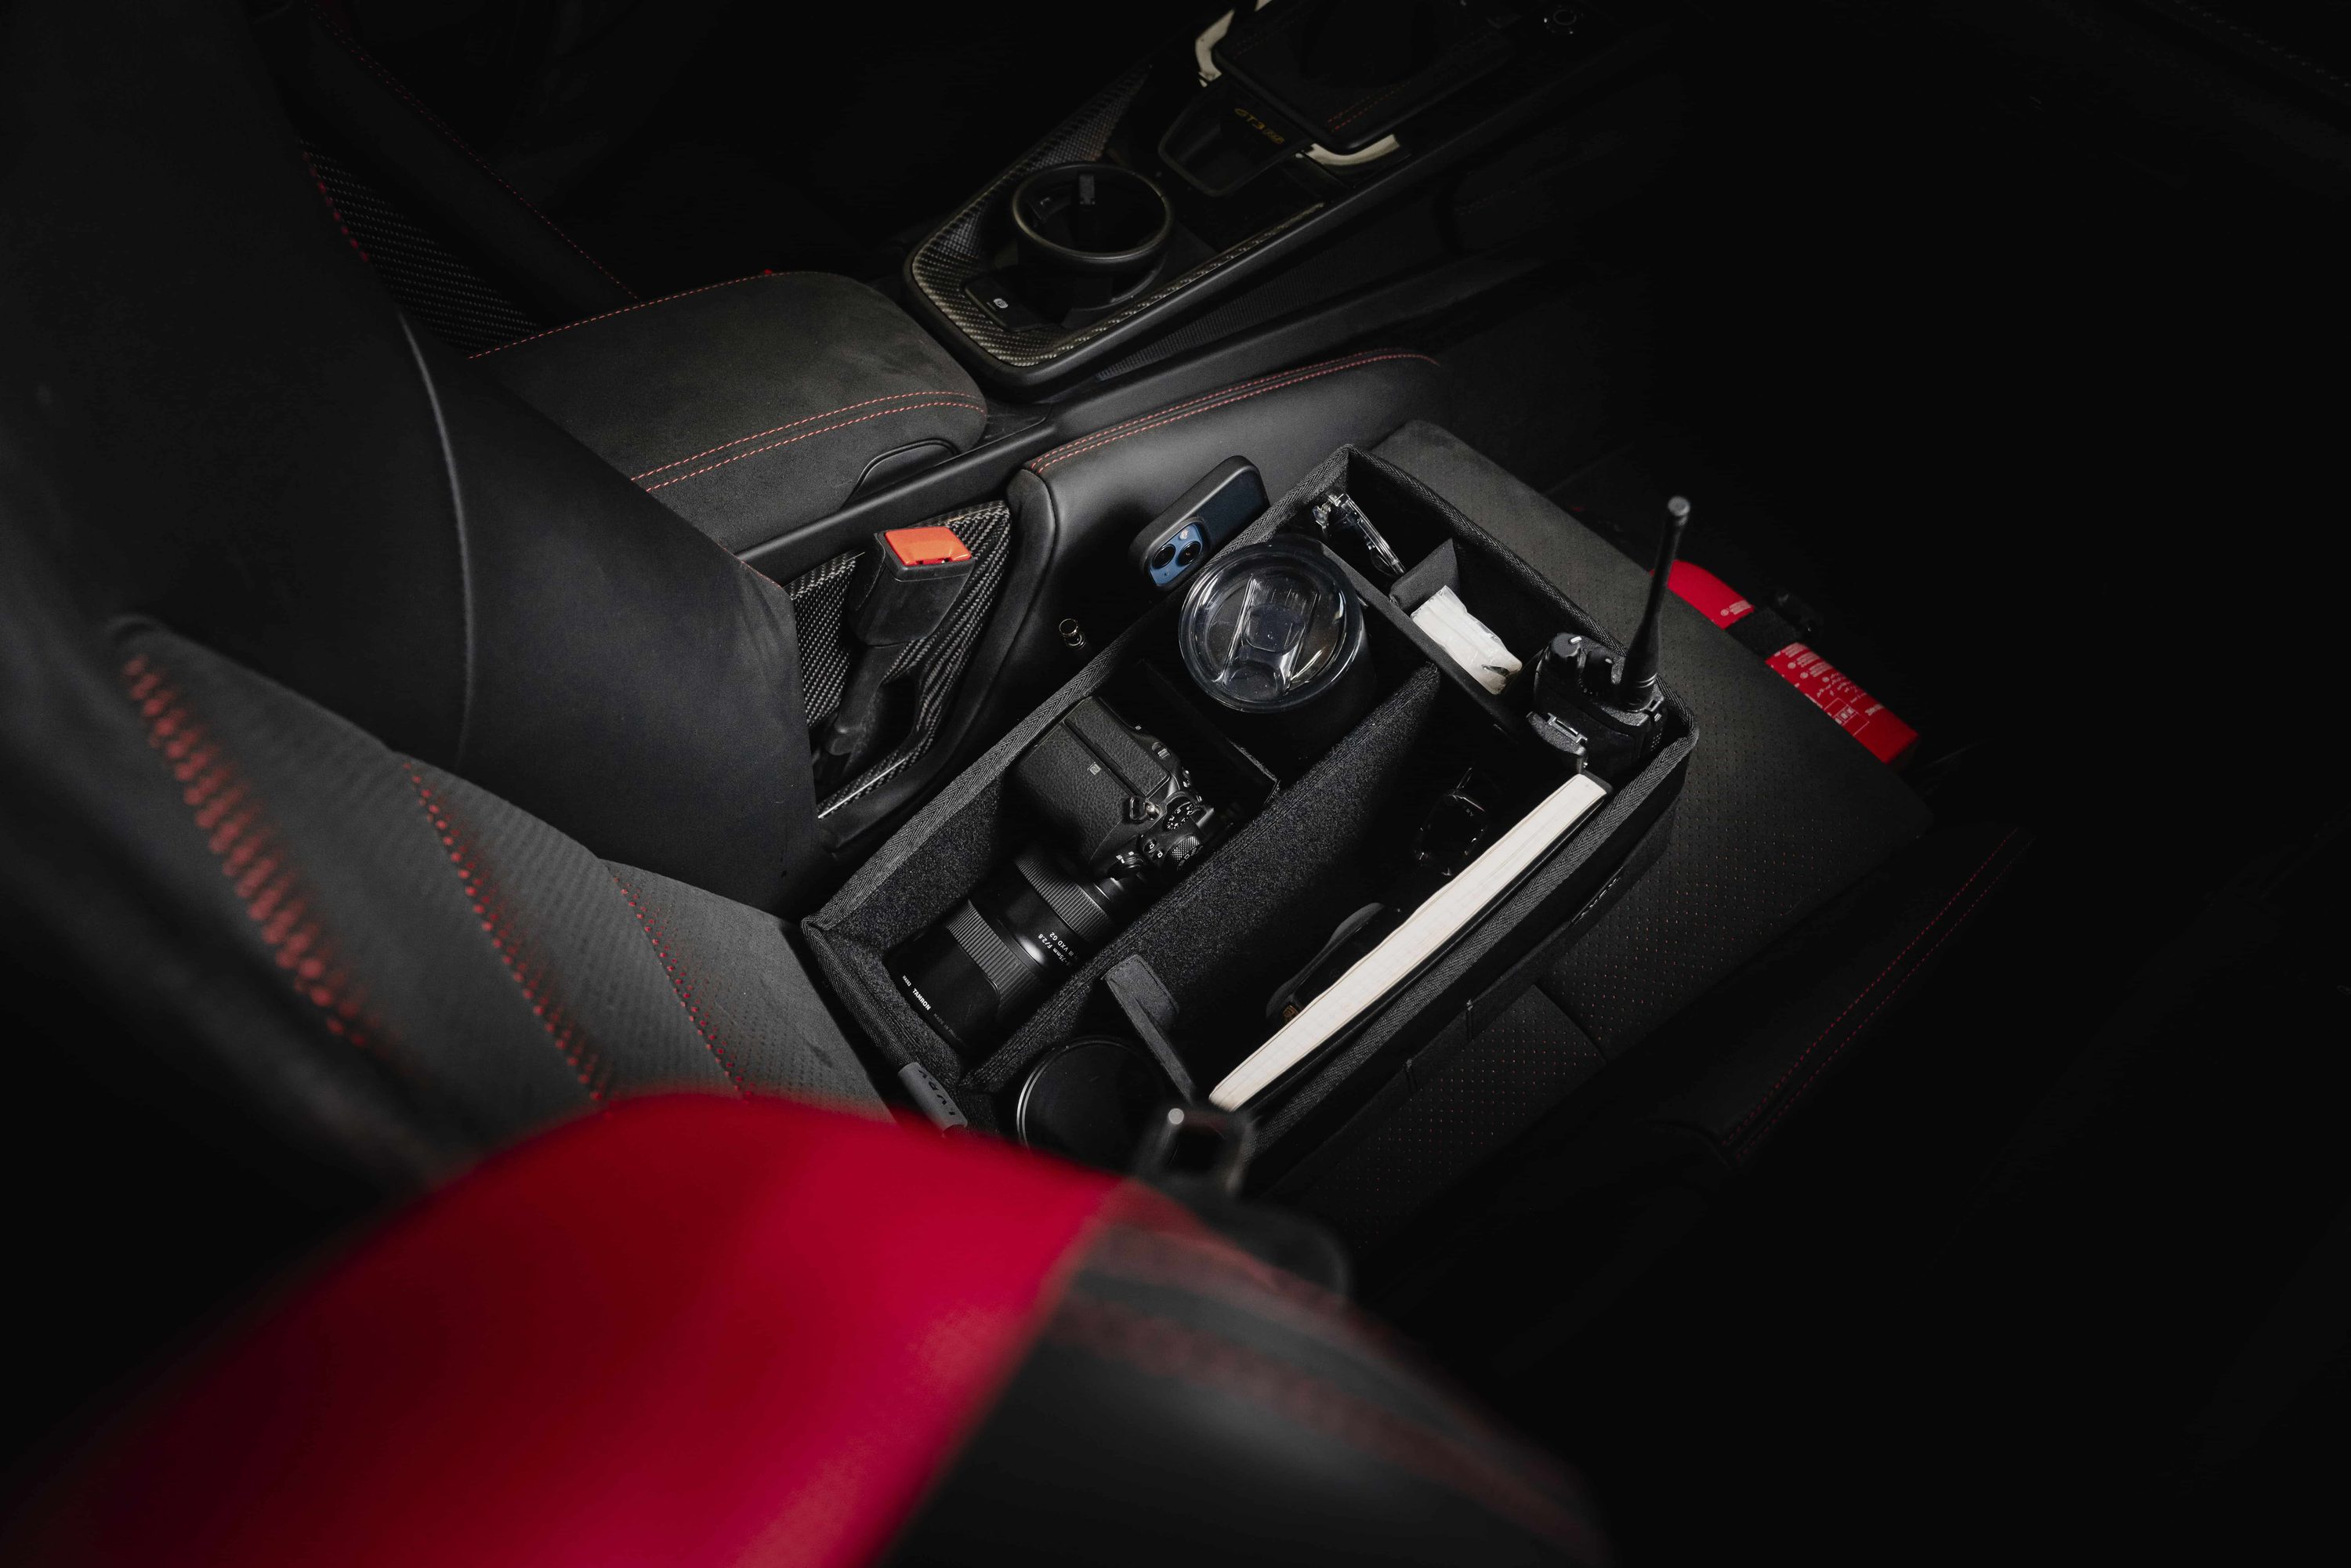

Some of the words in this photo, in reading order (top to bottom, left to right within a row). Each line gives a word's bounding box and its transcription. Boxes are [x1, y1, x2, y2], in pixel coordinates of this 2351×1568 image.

[1235, 108, 1266, 130] GT3
[1038, 933, 1053, 949] F/2.8
[1049, 932, 1058, 941] G2
[1057, 940, 1069, 952] VXD
[912, 987, 931, 1011] TAMRON
